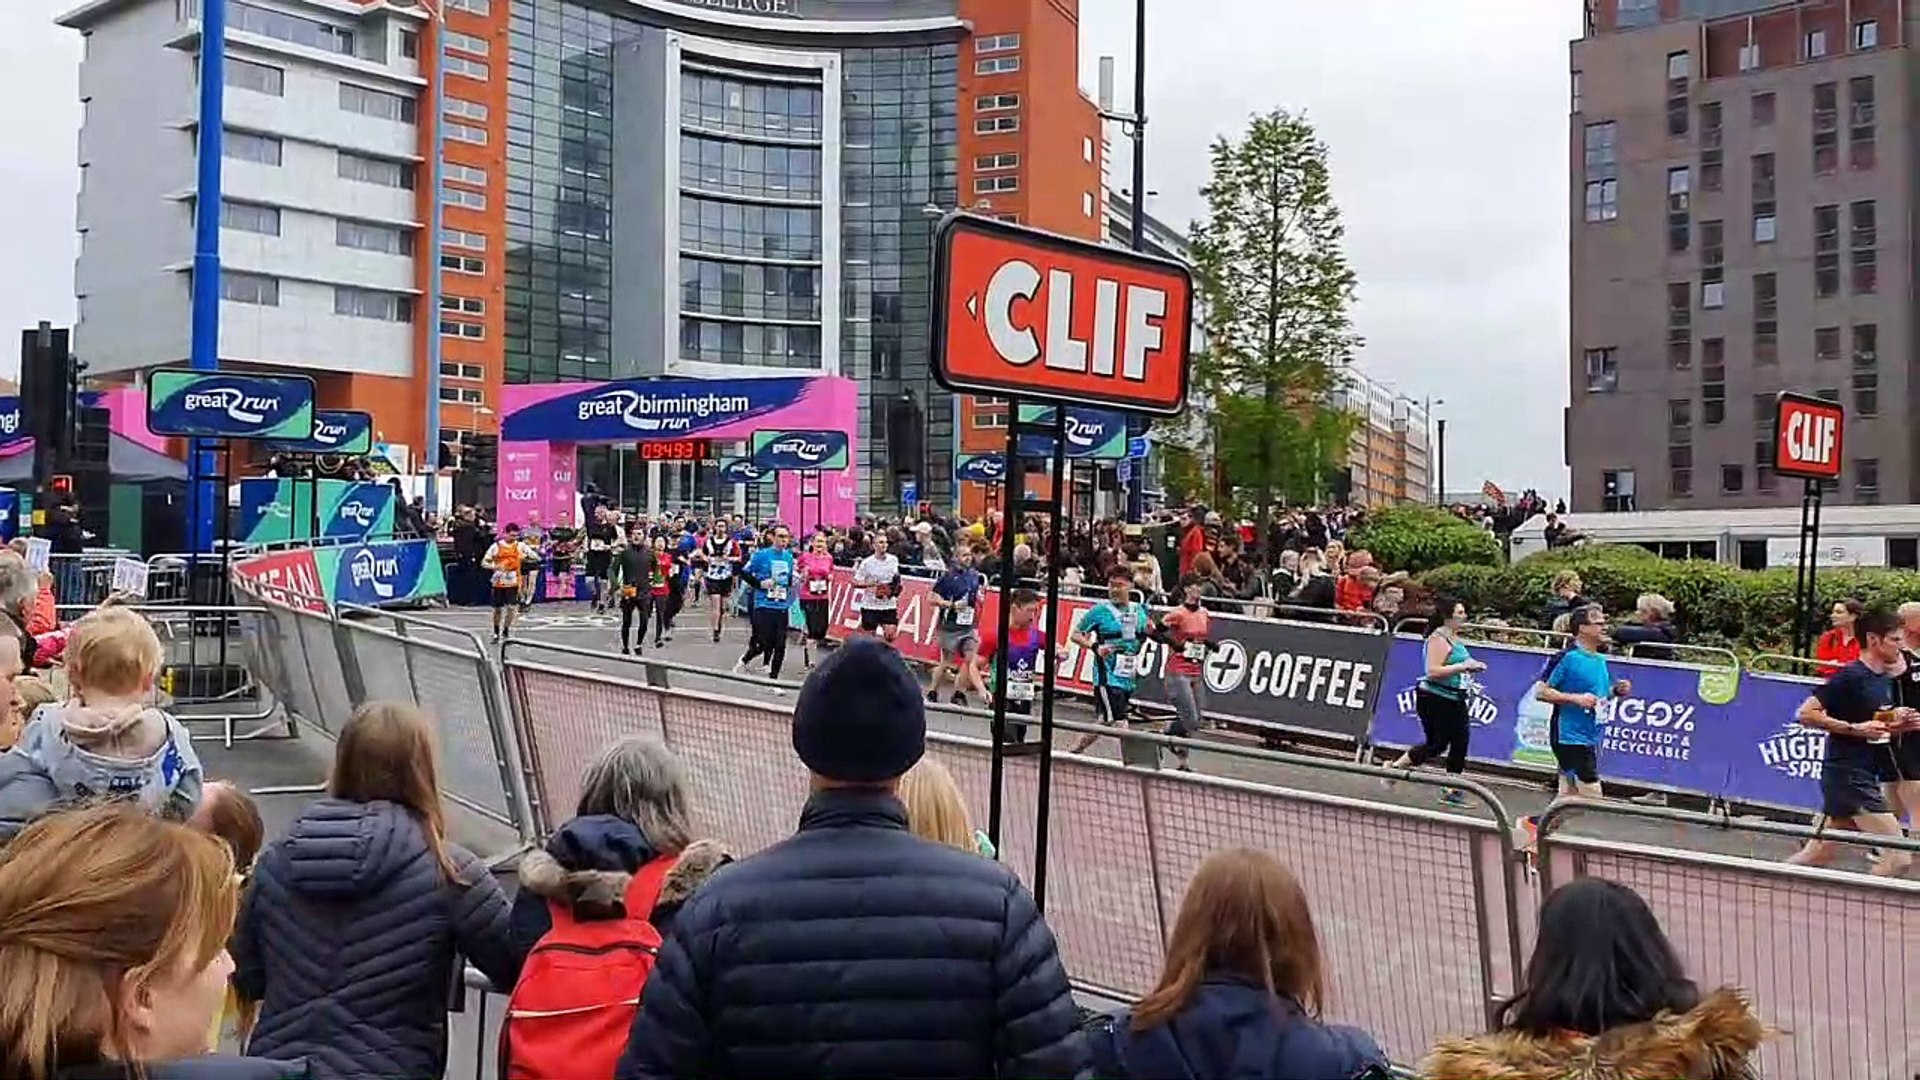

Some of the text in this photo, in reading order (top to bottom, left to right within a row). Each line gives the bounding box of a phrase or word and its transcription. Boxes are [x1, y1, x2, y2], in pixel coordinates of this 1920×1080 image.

[984, 258, 1166, 381] CLIF
[185, 392, 279, 411] great run
[578, 393, 749, 420] great birmingham
[322, 424, 347, 435] run
[660, 417, 691, 430] run
[1078, 422, 1104, 435] run
[1787, 410, 1836, 464] CLIF
[376, 557, 399, 577] run
[1250, 650, 1373, 709] COFFEE
[1602, 738, 1691, 760] RECYCLABLE
[1681, 735, 1691, 747] &
